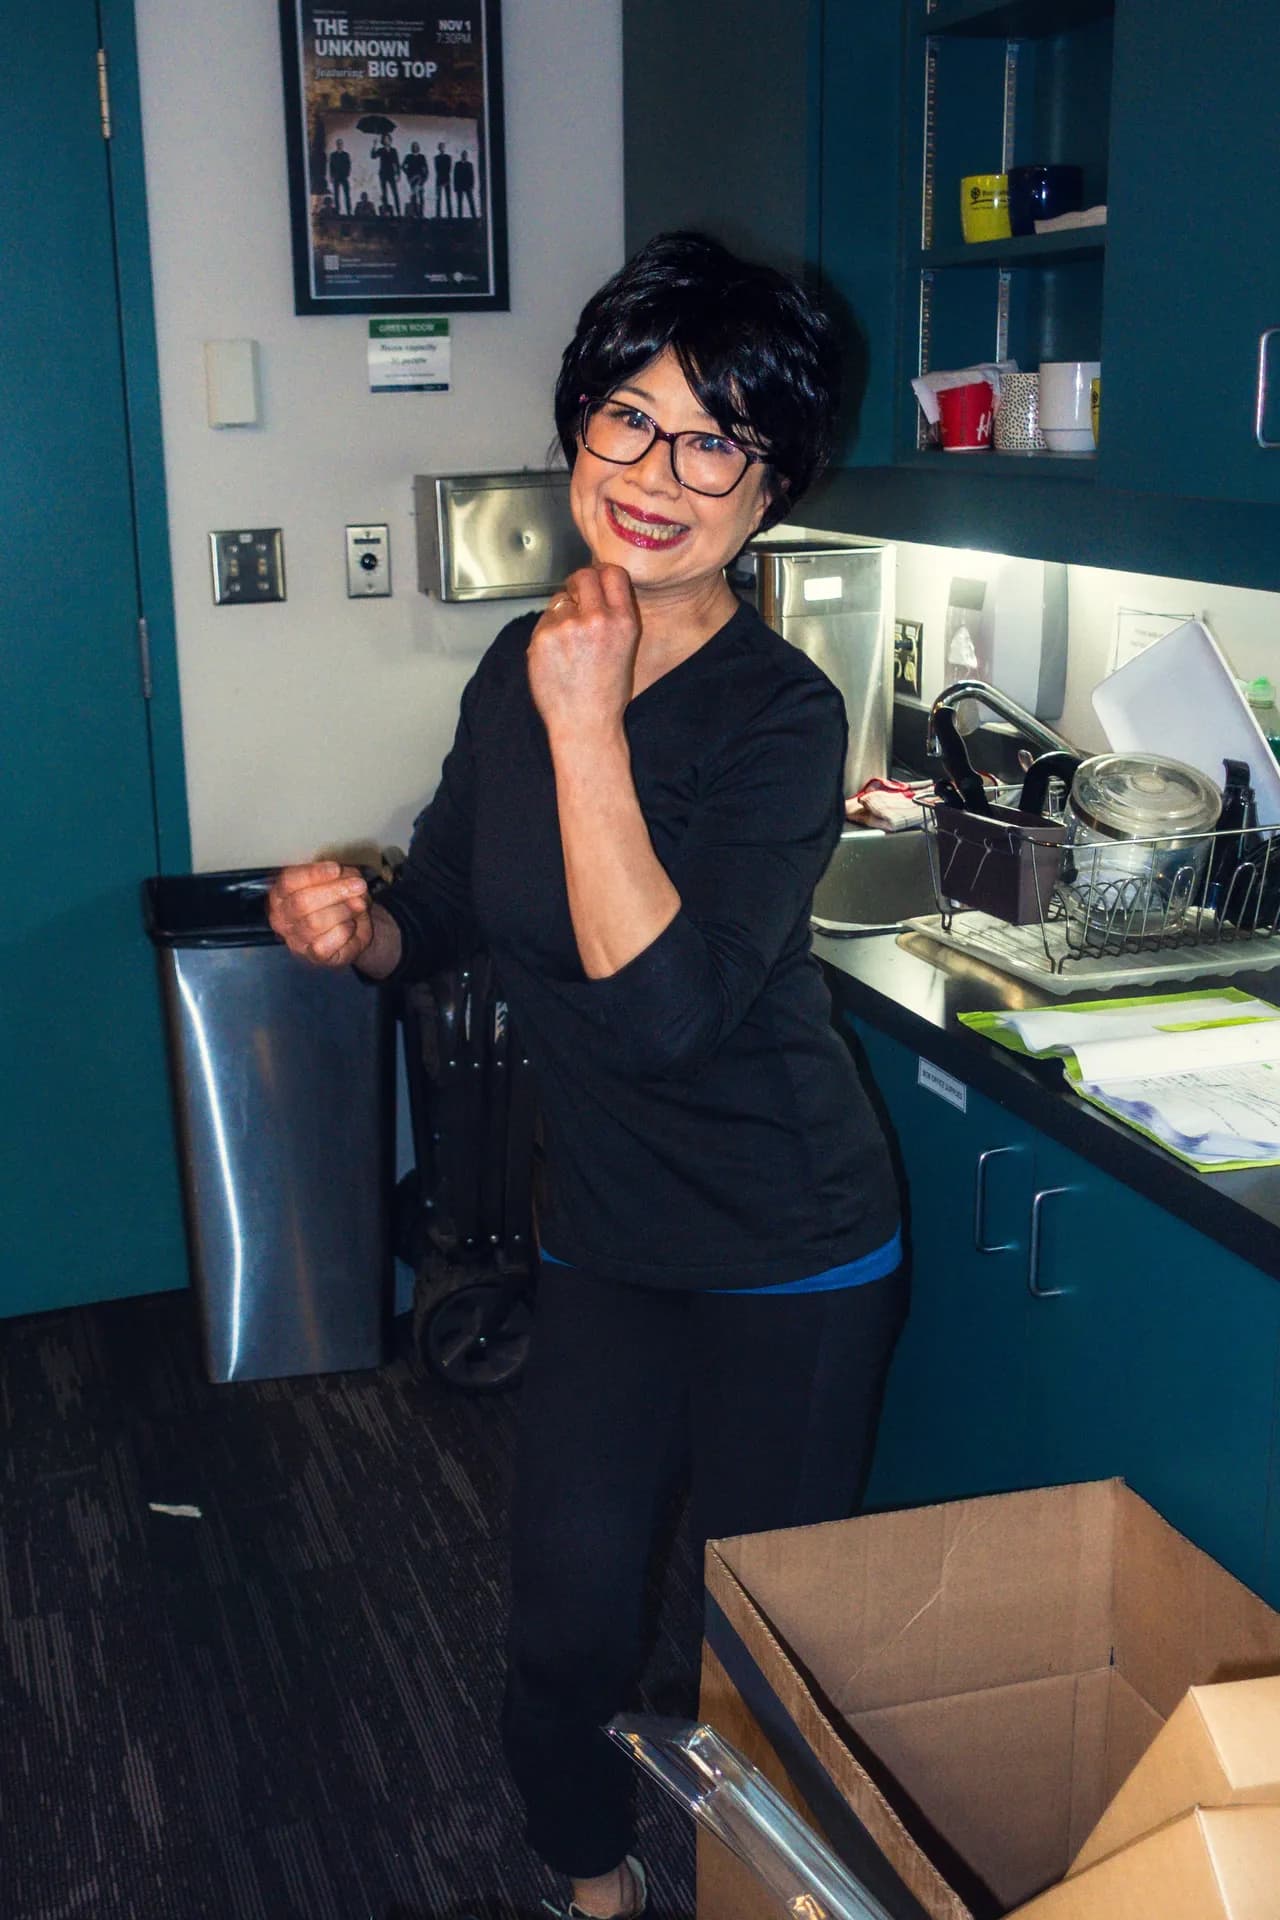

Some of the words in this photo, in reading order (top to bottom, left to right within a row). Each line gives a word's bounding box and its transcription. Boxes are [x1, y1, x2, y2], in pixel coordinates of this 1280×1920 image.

[314, 19, 348, 36] THE
[439, 20, 463, 31] NOV
[465, 20, 472, 31] 1
[315, 40, 409, 57] UNKNOWN
[367, 61, 399, 77] BIG
[402, 62, 438, 78] TOP
